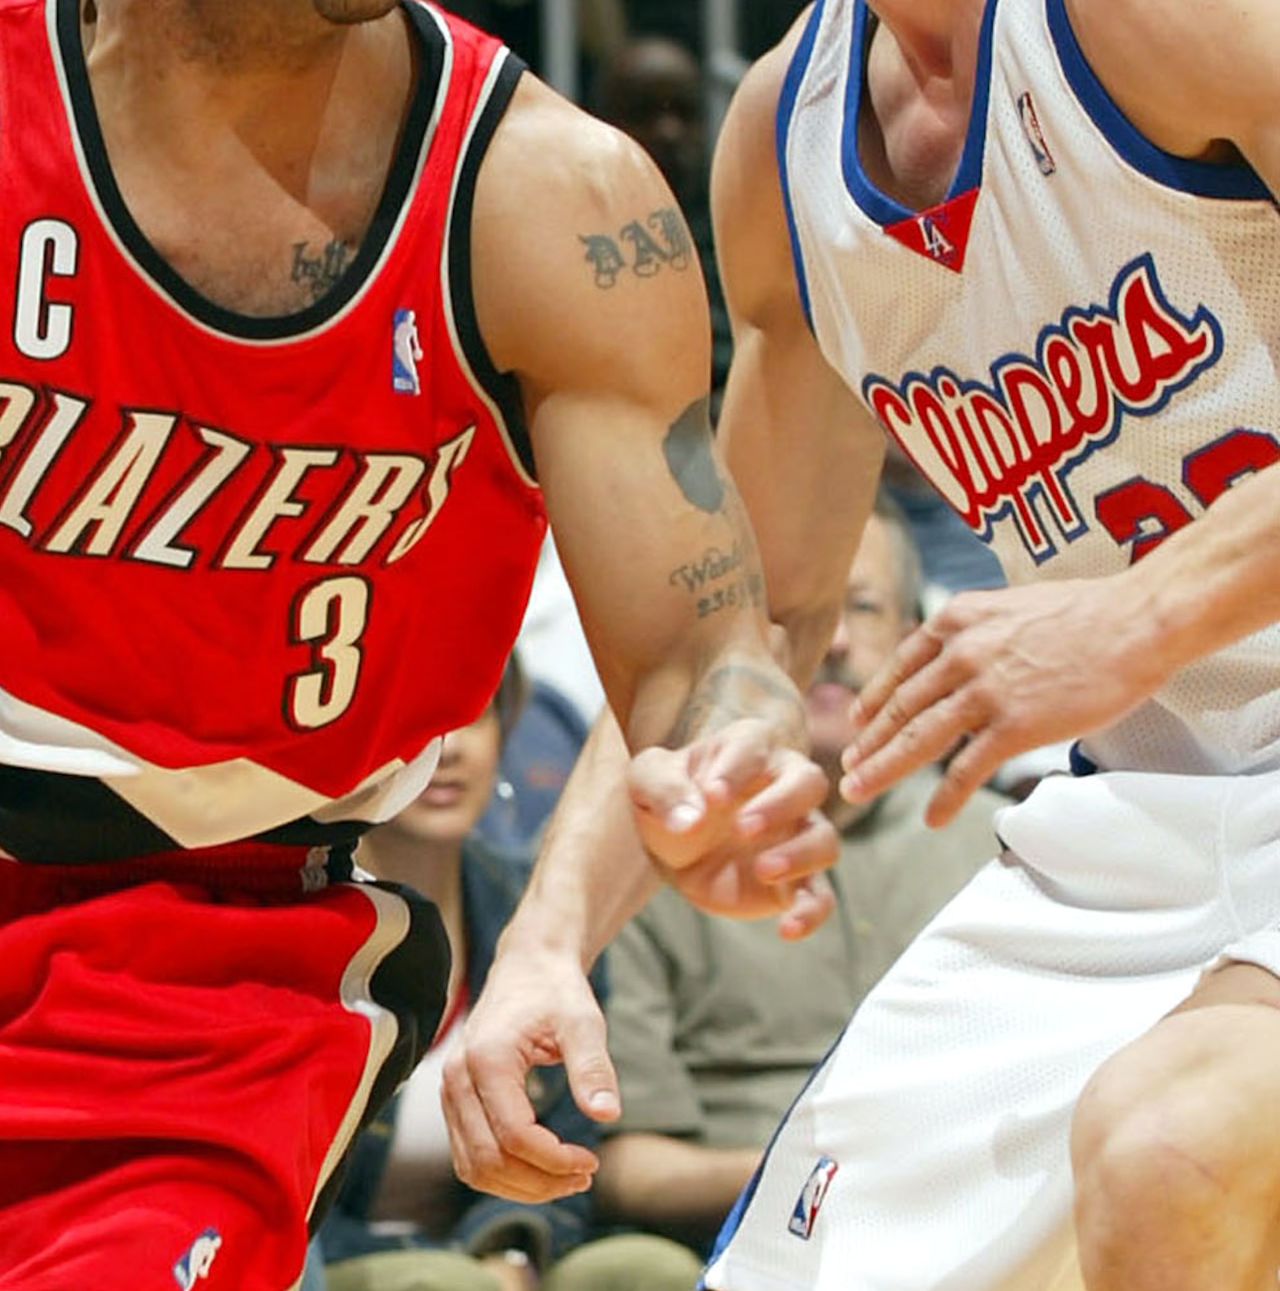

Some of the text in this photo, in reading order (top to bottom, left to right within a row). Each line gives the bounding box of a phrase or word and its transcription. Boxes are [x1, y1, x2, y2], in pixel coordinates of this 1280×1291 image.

[13, 218, 78, 361] C
[862, 251, 1224, 566] Clippers
[282, 574, 373, 731] 3
